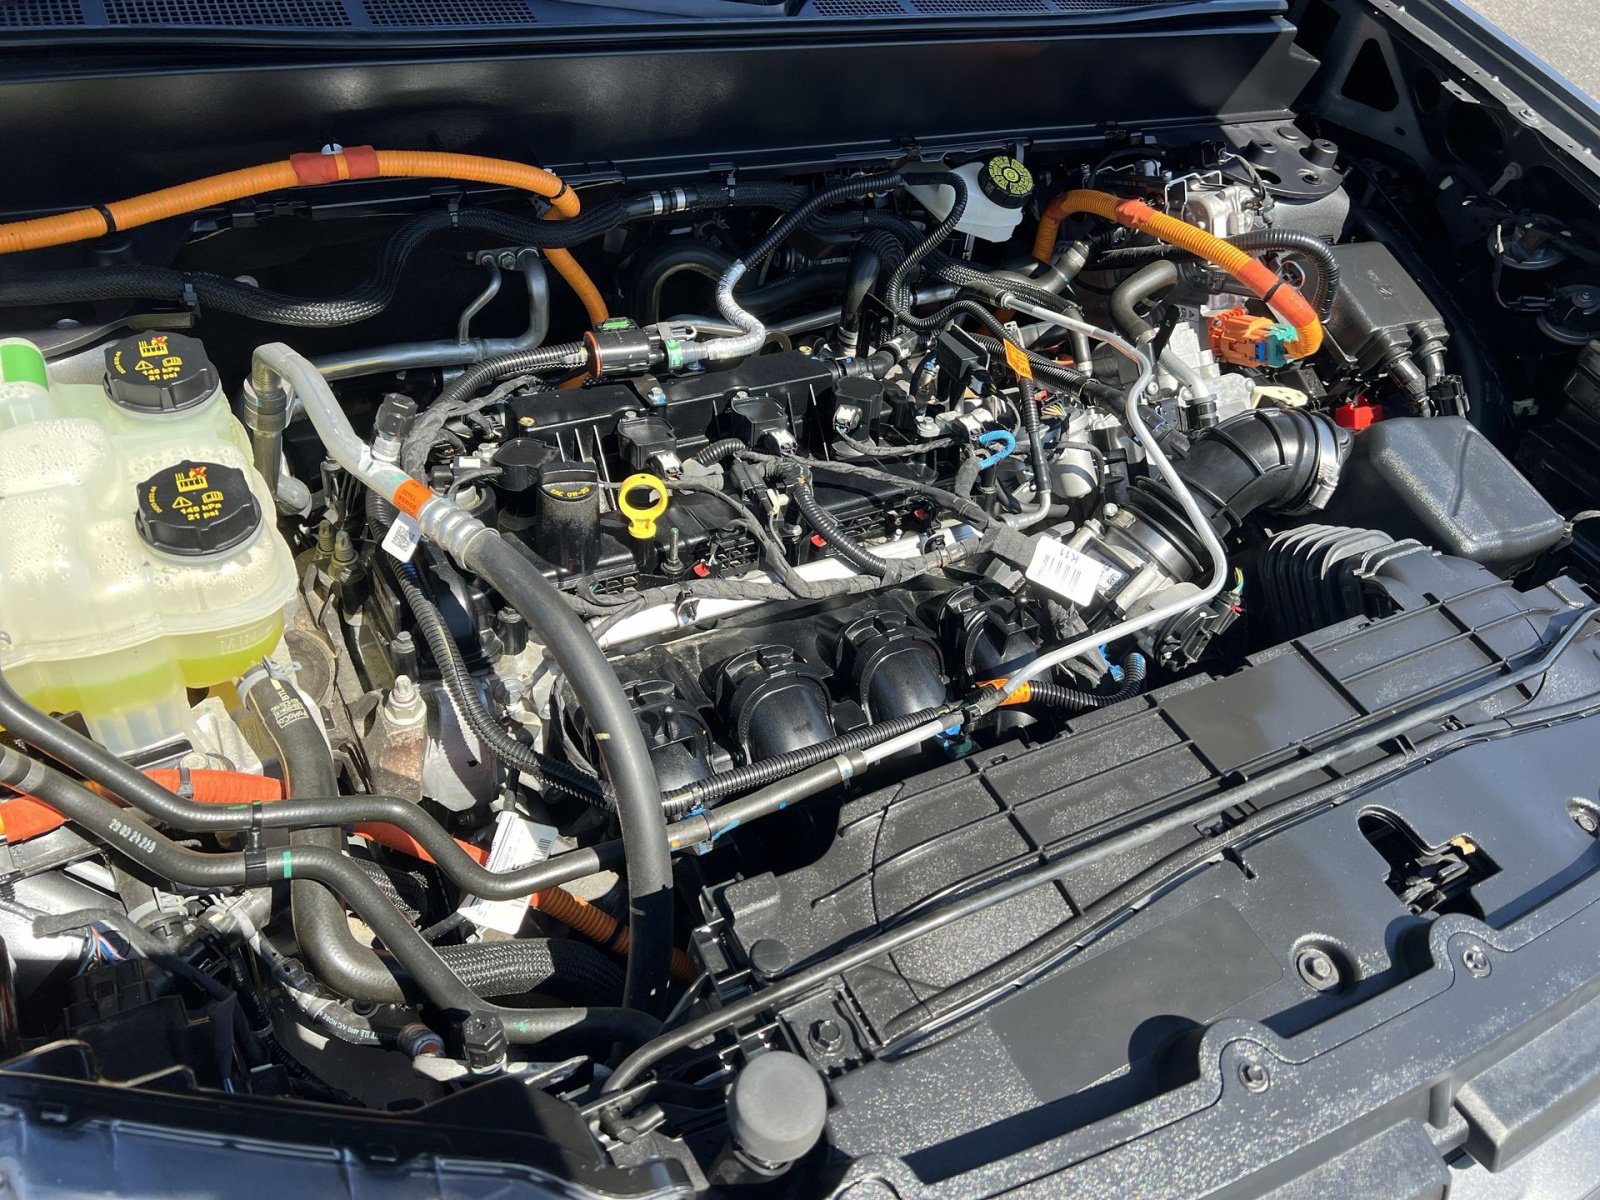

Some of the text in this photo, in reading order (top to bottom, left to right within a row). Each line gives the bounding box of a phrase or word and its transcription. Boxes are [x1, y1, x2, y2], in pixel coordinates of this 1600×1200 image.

[162, 366, 181, 374] kPa
[162, 372, 178, 381] psi
[180, 503, 222, 514] 145 kPa
[187, 509, 219, 521] 21 psi
